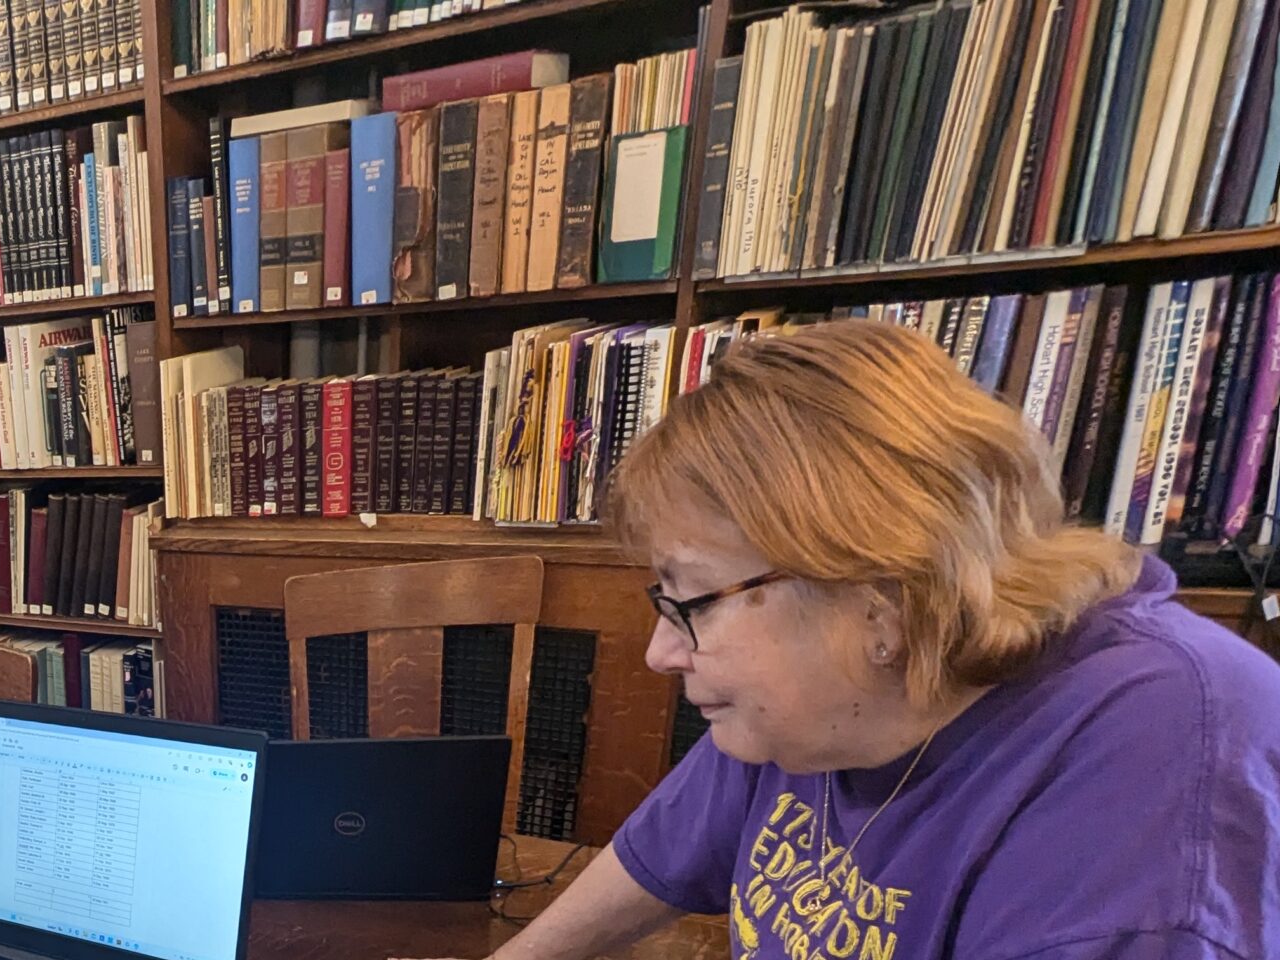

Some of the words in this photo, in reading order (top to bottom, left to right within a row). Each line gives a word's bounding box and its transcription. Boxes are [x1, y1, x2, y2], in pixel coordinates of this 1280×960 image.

[745, 179, 758, 226] Aurora
[1151, 307, 1164, 338] Hobart
[1186, 308, 1205, 360] HOBART
[1040, 325, 1060, 366] Hobart
[1145, 340, 1158, 362] High
[1033, 368, 1049, 395] High
[1139, 363, 1154, 394] School
[1180, 365, 1193, 396] HIGH
[1168, 399, 1187, 448] SCHOOL
[745, 873, 777, 919] IN
[856, 884, 912, 925] OF
